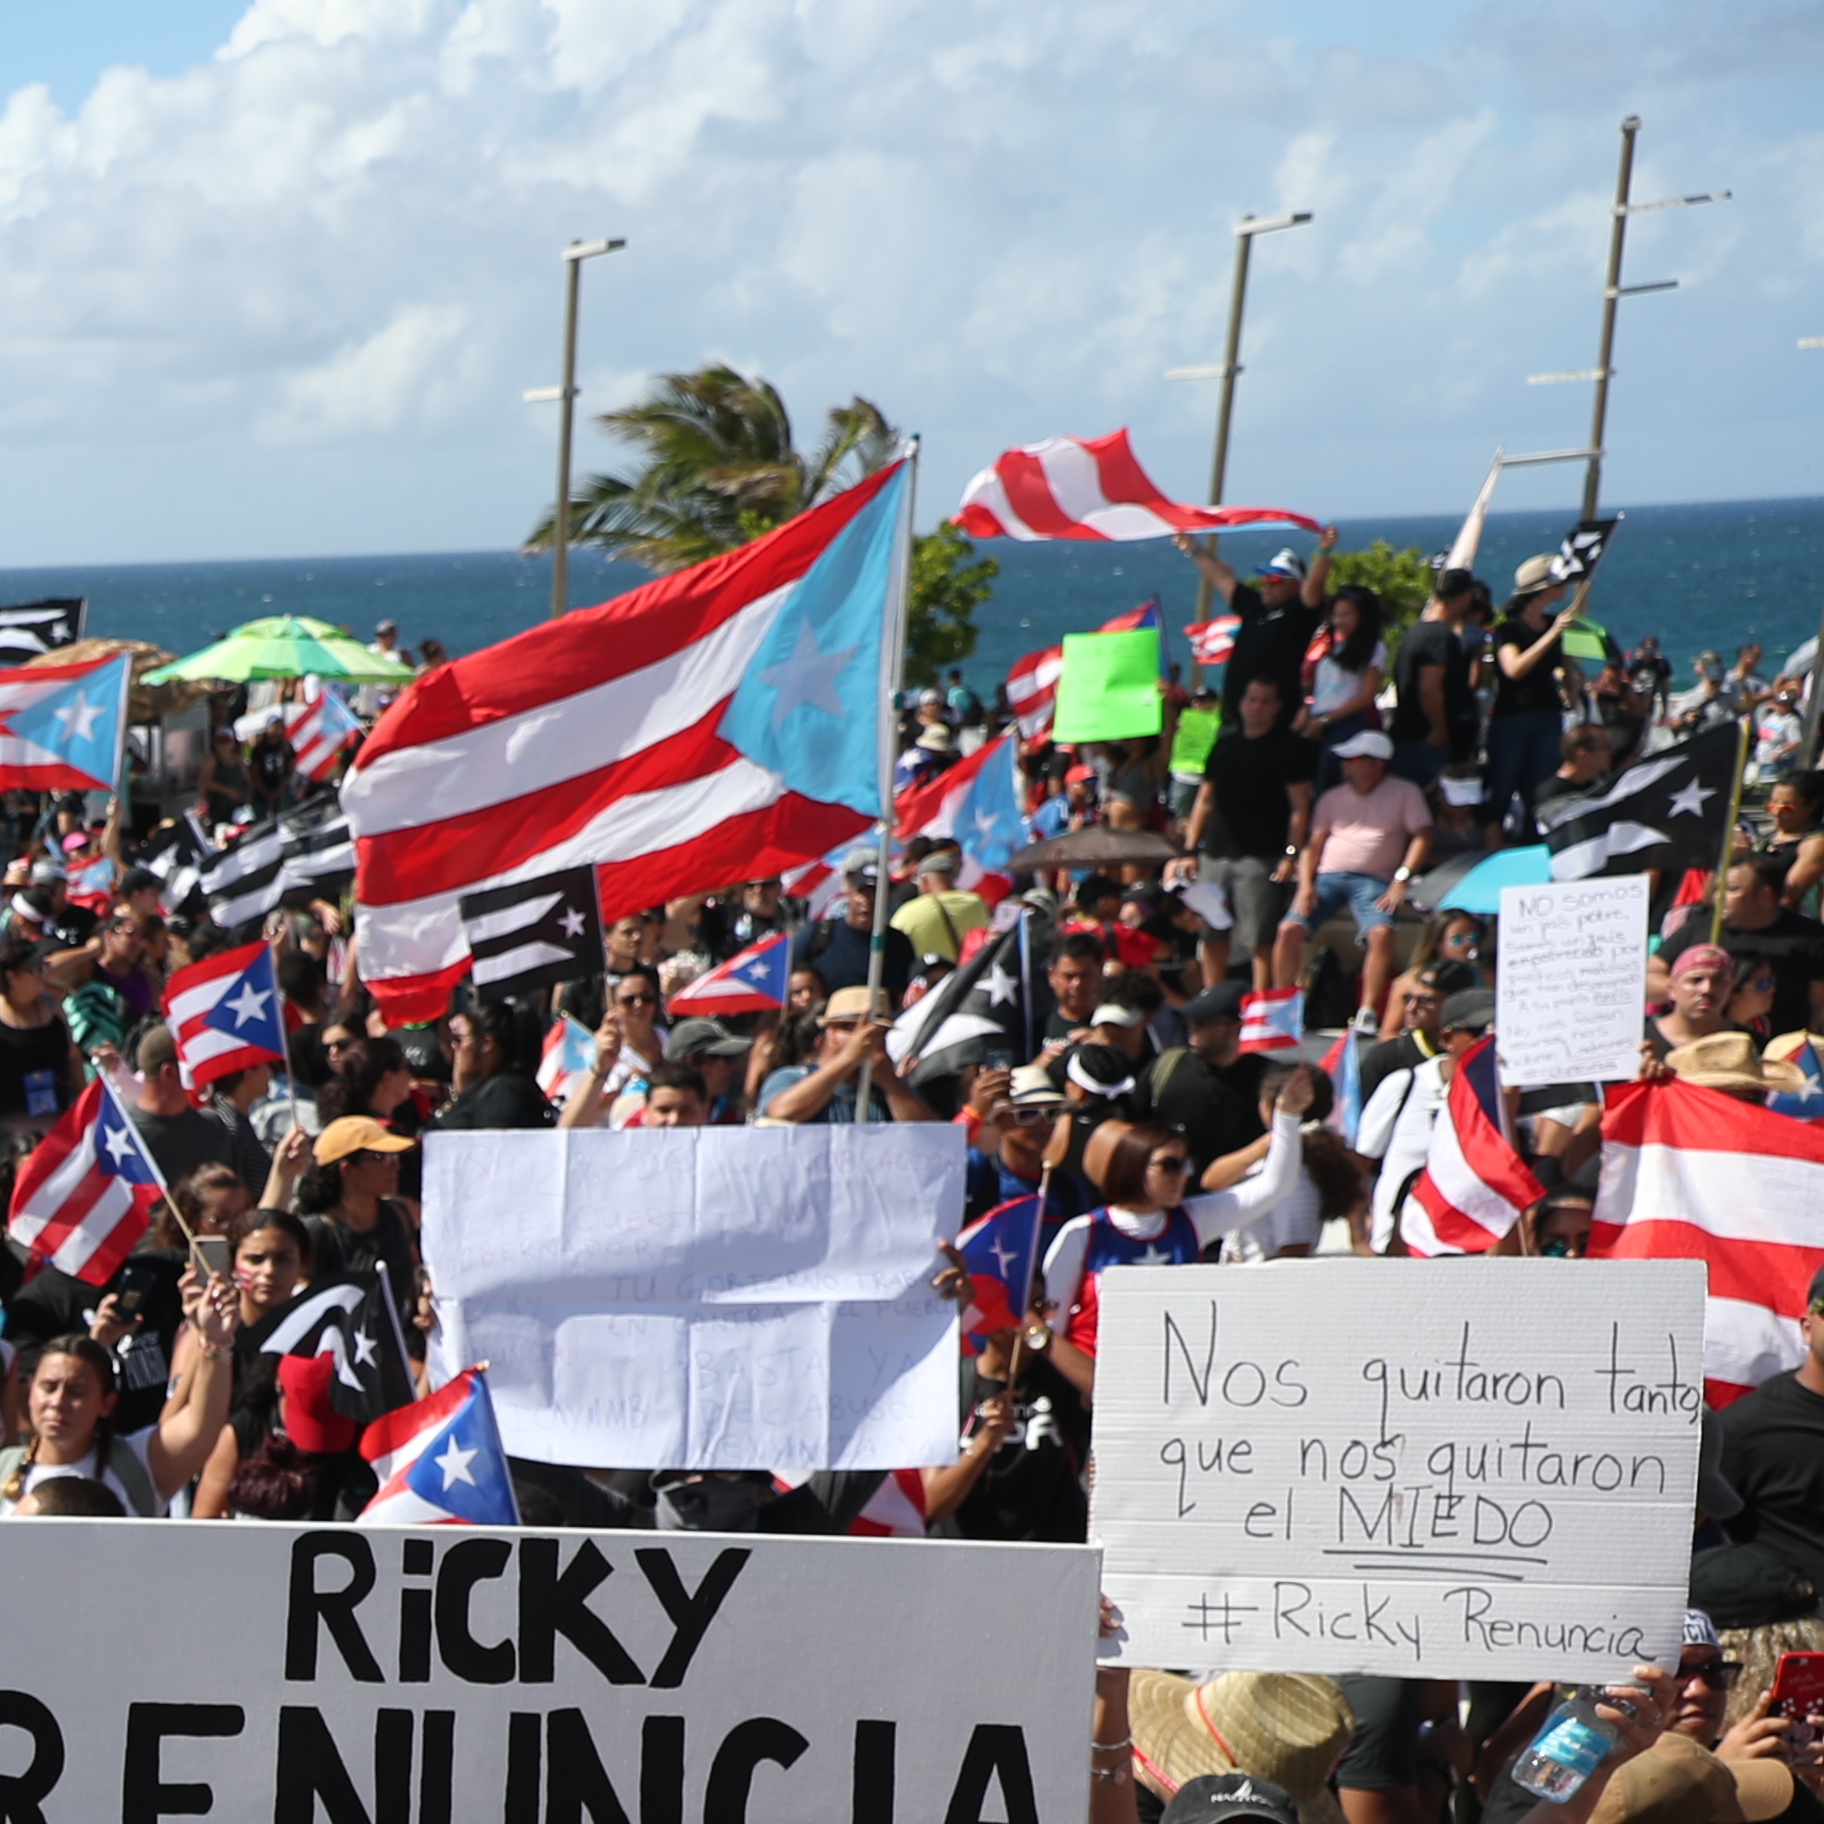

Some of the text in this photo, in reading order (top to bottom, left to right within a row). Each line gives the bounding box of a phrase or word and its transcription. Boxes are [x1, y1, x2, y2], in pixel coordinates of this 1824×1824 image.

[1163, 1300, 1308, 1408] Nos
[1361, 1320, 1566, 1448] quitaron
[1159, 1419, 1666, 1519] que nos quitaron
[1243, 1483, 1554, 1550] el MIEDO
[1442, 1586, 1658, 1664] Renuncia
